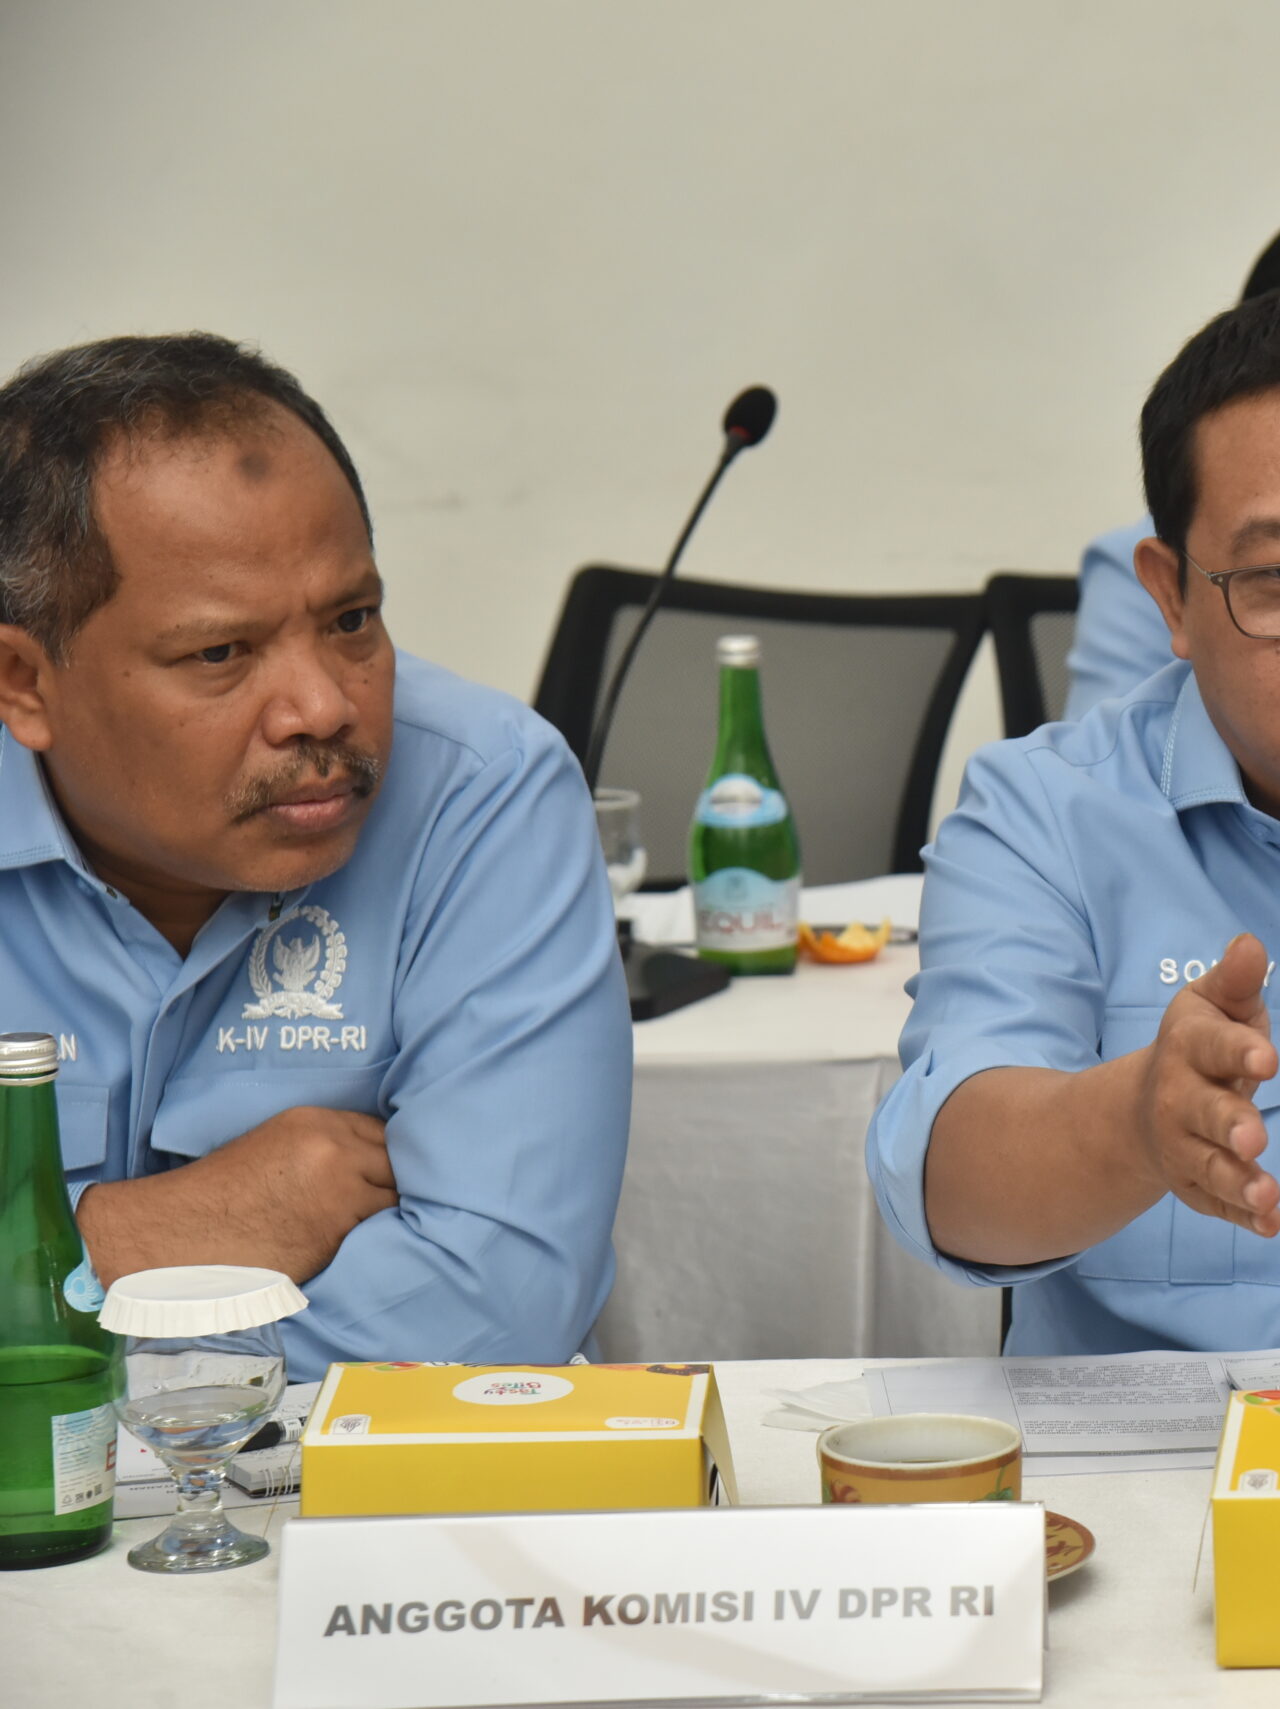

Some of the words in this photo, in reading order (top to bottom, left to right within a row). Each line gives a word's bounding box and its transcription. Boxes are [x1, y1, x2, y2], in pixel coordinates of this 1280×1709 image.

[217, 1026, 270, 1053] K-IV
[280, 1025, 367, 1051] DPR-RI
[323, 1597, 565, 1637] ANGGOTA
[581, 1590, 755, 1627] KOMISI
[772, 1589, 822, 1621] IV
[837, 1586, 932, 1619] DPR
[949, 1584, 995, 1617] RI
